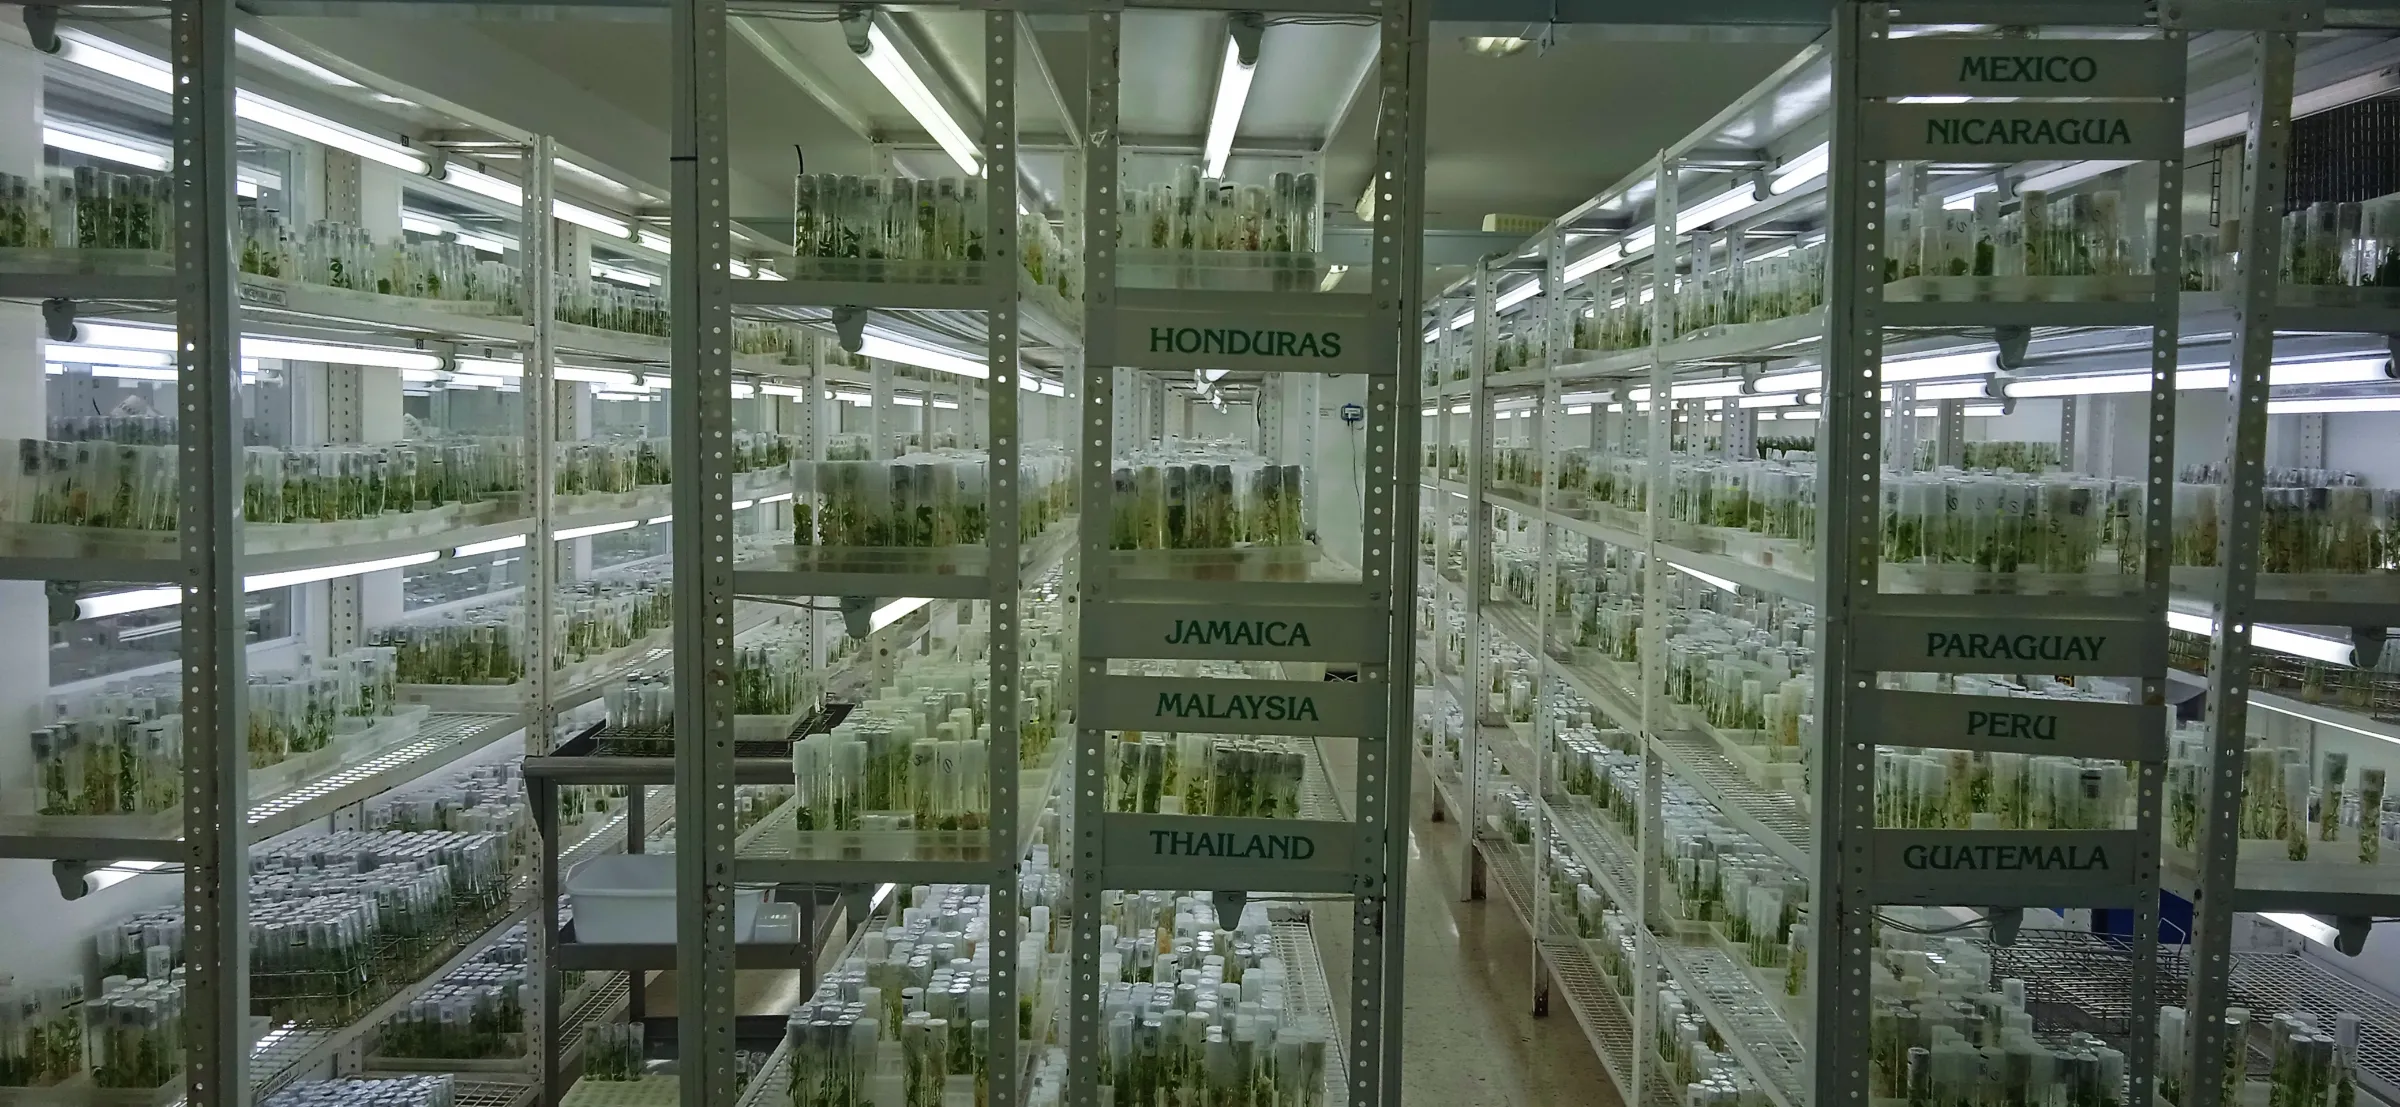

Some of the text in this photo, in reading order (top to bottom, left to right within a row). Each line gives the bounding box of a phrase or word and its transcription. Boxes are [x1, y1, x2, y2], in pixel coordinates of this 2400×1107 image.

[1960, 57, 2096, 82] MEXICO
[1927, 119, 2131, 144] NICARAGUA
[1150, 328, 1341, 357] HONDURAS
[1166, 620, 1310, 646] JAMAICA
[1927, 633, 2106, 661] PARAGUAY
[1156, 693, 1318, 721] MALAYSIA
[1968, 712, 2057, 740] PERU
[1150, 831, 1314, 859] THAILAND
[1904, 845, 2109, 870] GUATEMALA
